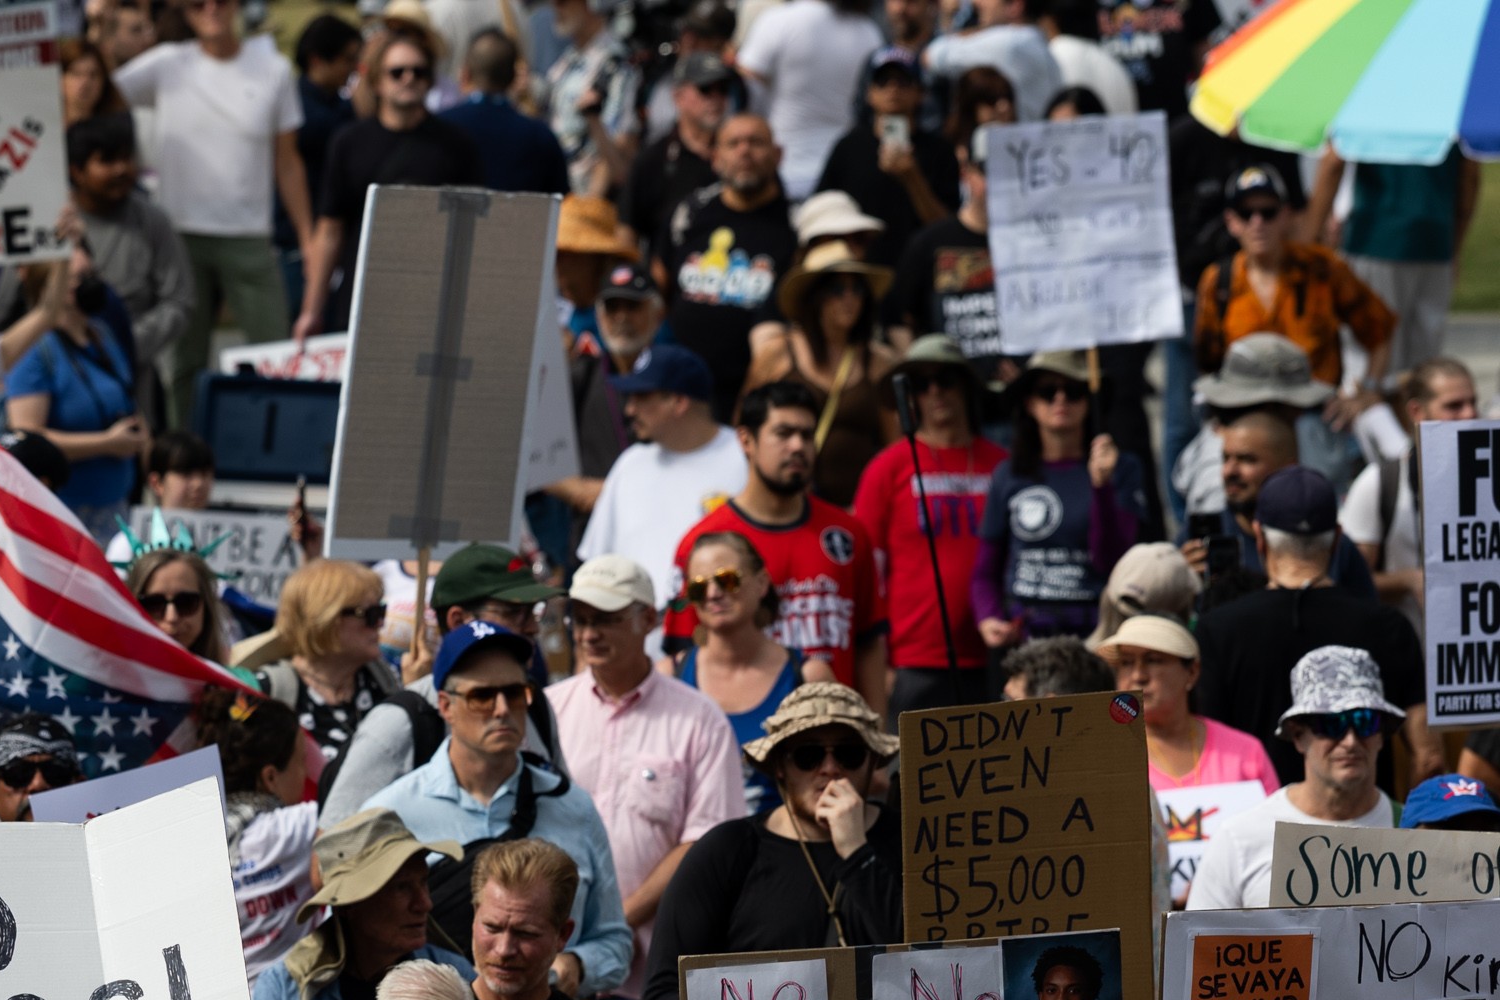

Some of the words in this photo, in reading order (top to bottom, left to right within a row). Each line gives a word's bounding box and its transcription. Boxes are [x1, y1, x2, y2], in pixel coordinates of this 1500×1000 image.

[1006, 139, 1071, 196] YES
[233, 524, 267, 567] BE
[920, 702, 1073, 756] DIDN'T
[1438, 695, 1471, 712] PARTY
[1473, 693, 1492, 710] FOR
[918, 746, 1051, 804] EVEN
[914, 806, 1030, 854] NEED
[1061, 797, 1094, 831] A
[921, 854, 1086, 923] $5,000
[1286, 834, 1428, 906] Some
[1357, 919, 1432, 984] NO
